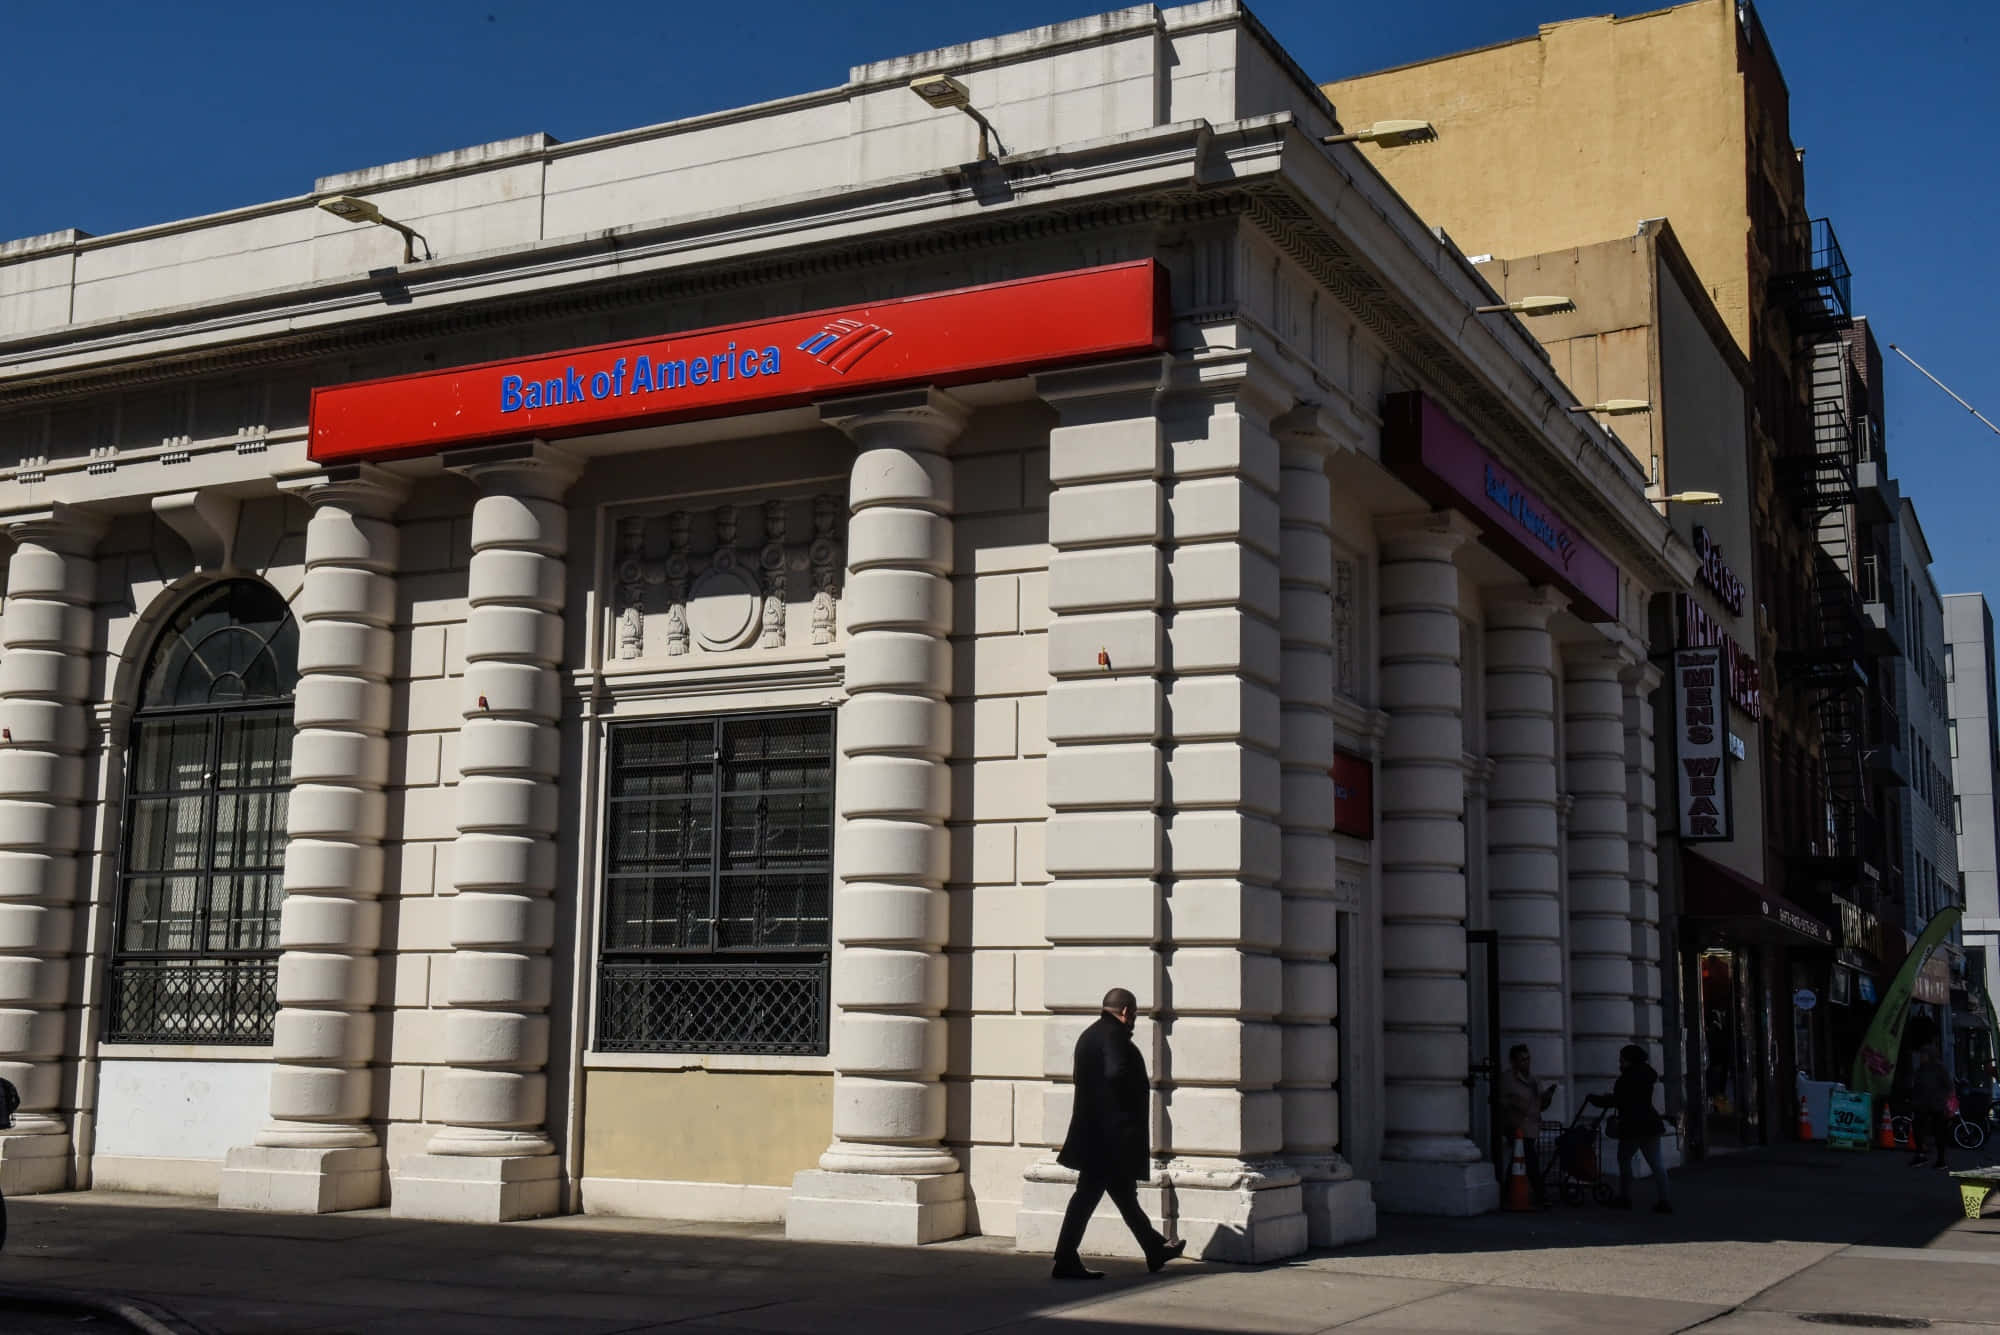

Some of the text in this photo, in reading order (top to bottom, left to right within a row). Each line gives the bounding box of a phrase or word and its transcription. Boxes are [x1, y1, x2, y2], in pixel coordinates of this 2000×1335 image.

[501, 341, 780, 412] Bank of America
[1683, 669, 1715, 745] MENS
[1683, 758, 1720, 834] WEAR
